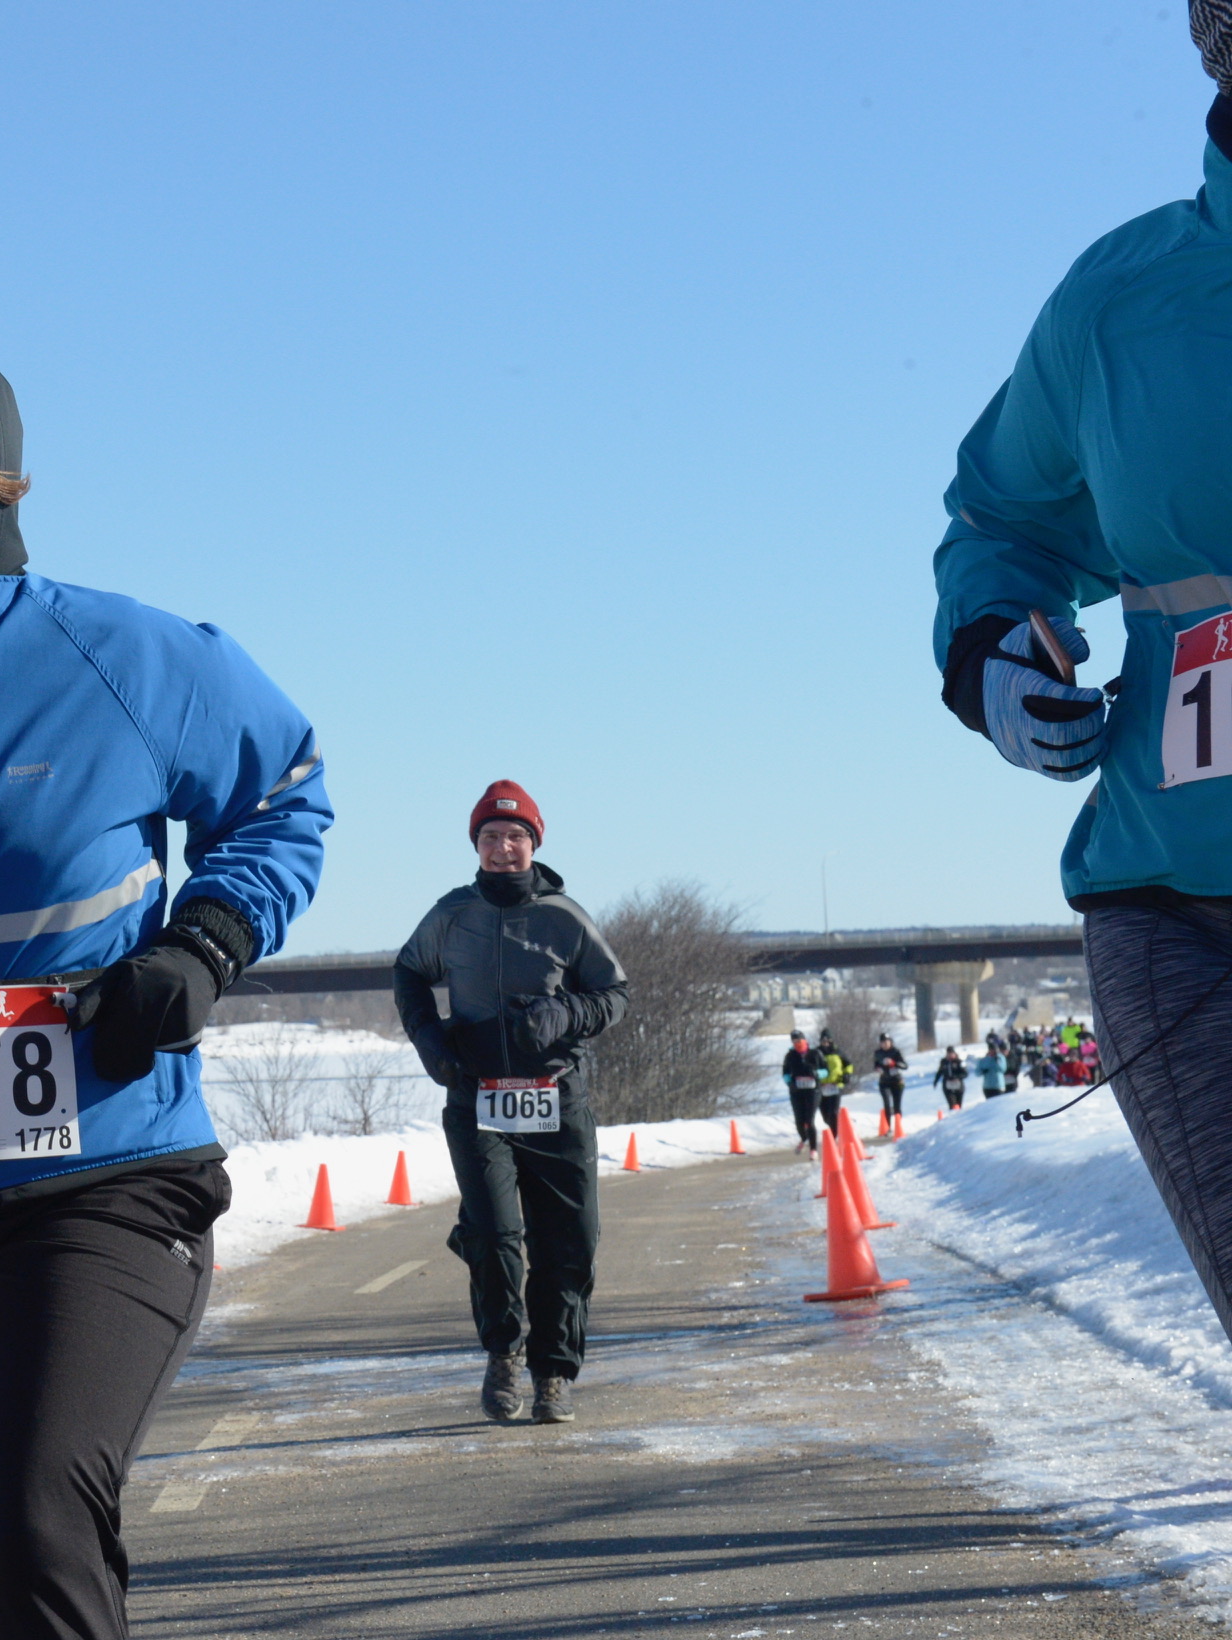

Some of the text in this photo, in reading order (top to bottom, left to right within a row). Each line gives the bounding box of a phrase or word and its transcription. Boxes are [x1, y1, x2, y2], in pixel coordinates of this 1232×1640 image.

[485, 1090, 552, 1119] 1065
[538, 1121, 557, 1131] 1065
[15, 1125, 72, 1153] 1778
[170, 1247, 190, 1265] RBX
